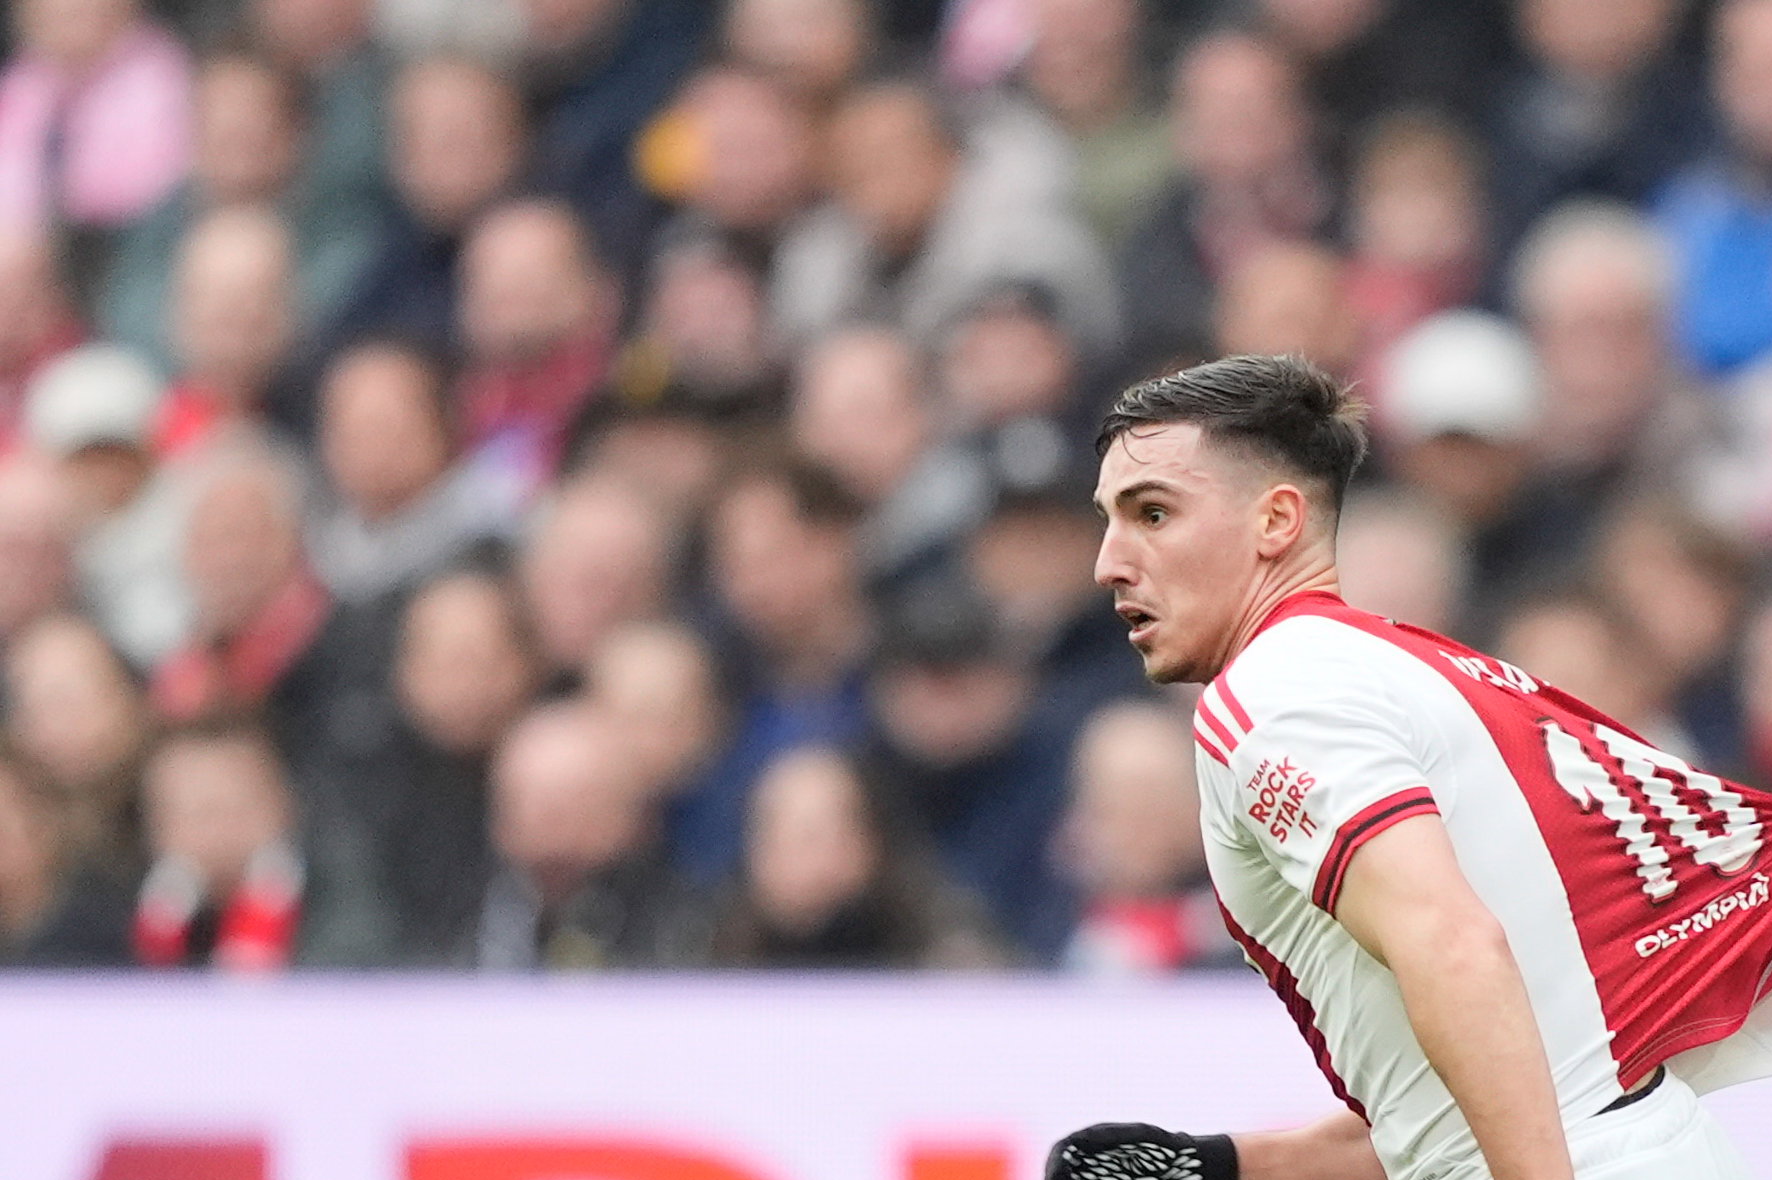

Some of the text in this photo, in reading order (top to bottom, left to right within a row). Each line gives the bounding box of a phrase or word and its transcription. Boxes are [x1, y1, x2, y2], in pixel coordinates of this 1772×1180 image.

[1246, 759, 1271, 792] TEAM
[1248, 754, 1299, 825] ROCK
[1270, 771, 1316, 844] STARS
[1538, 718, 1764, 904] 10
[1298, 810, 1318, 839] IT
